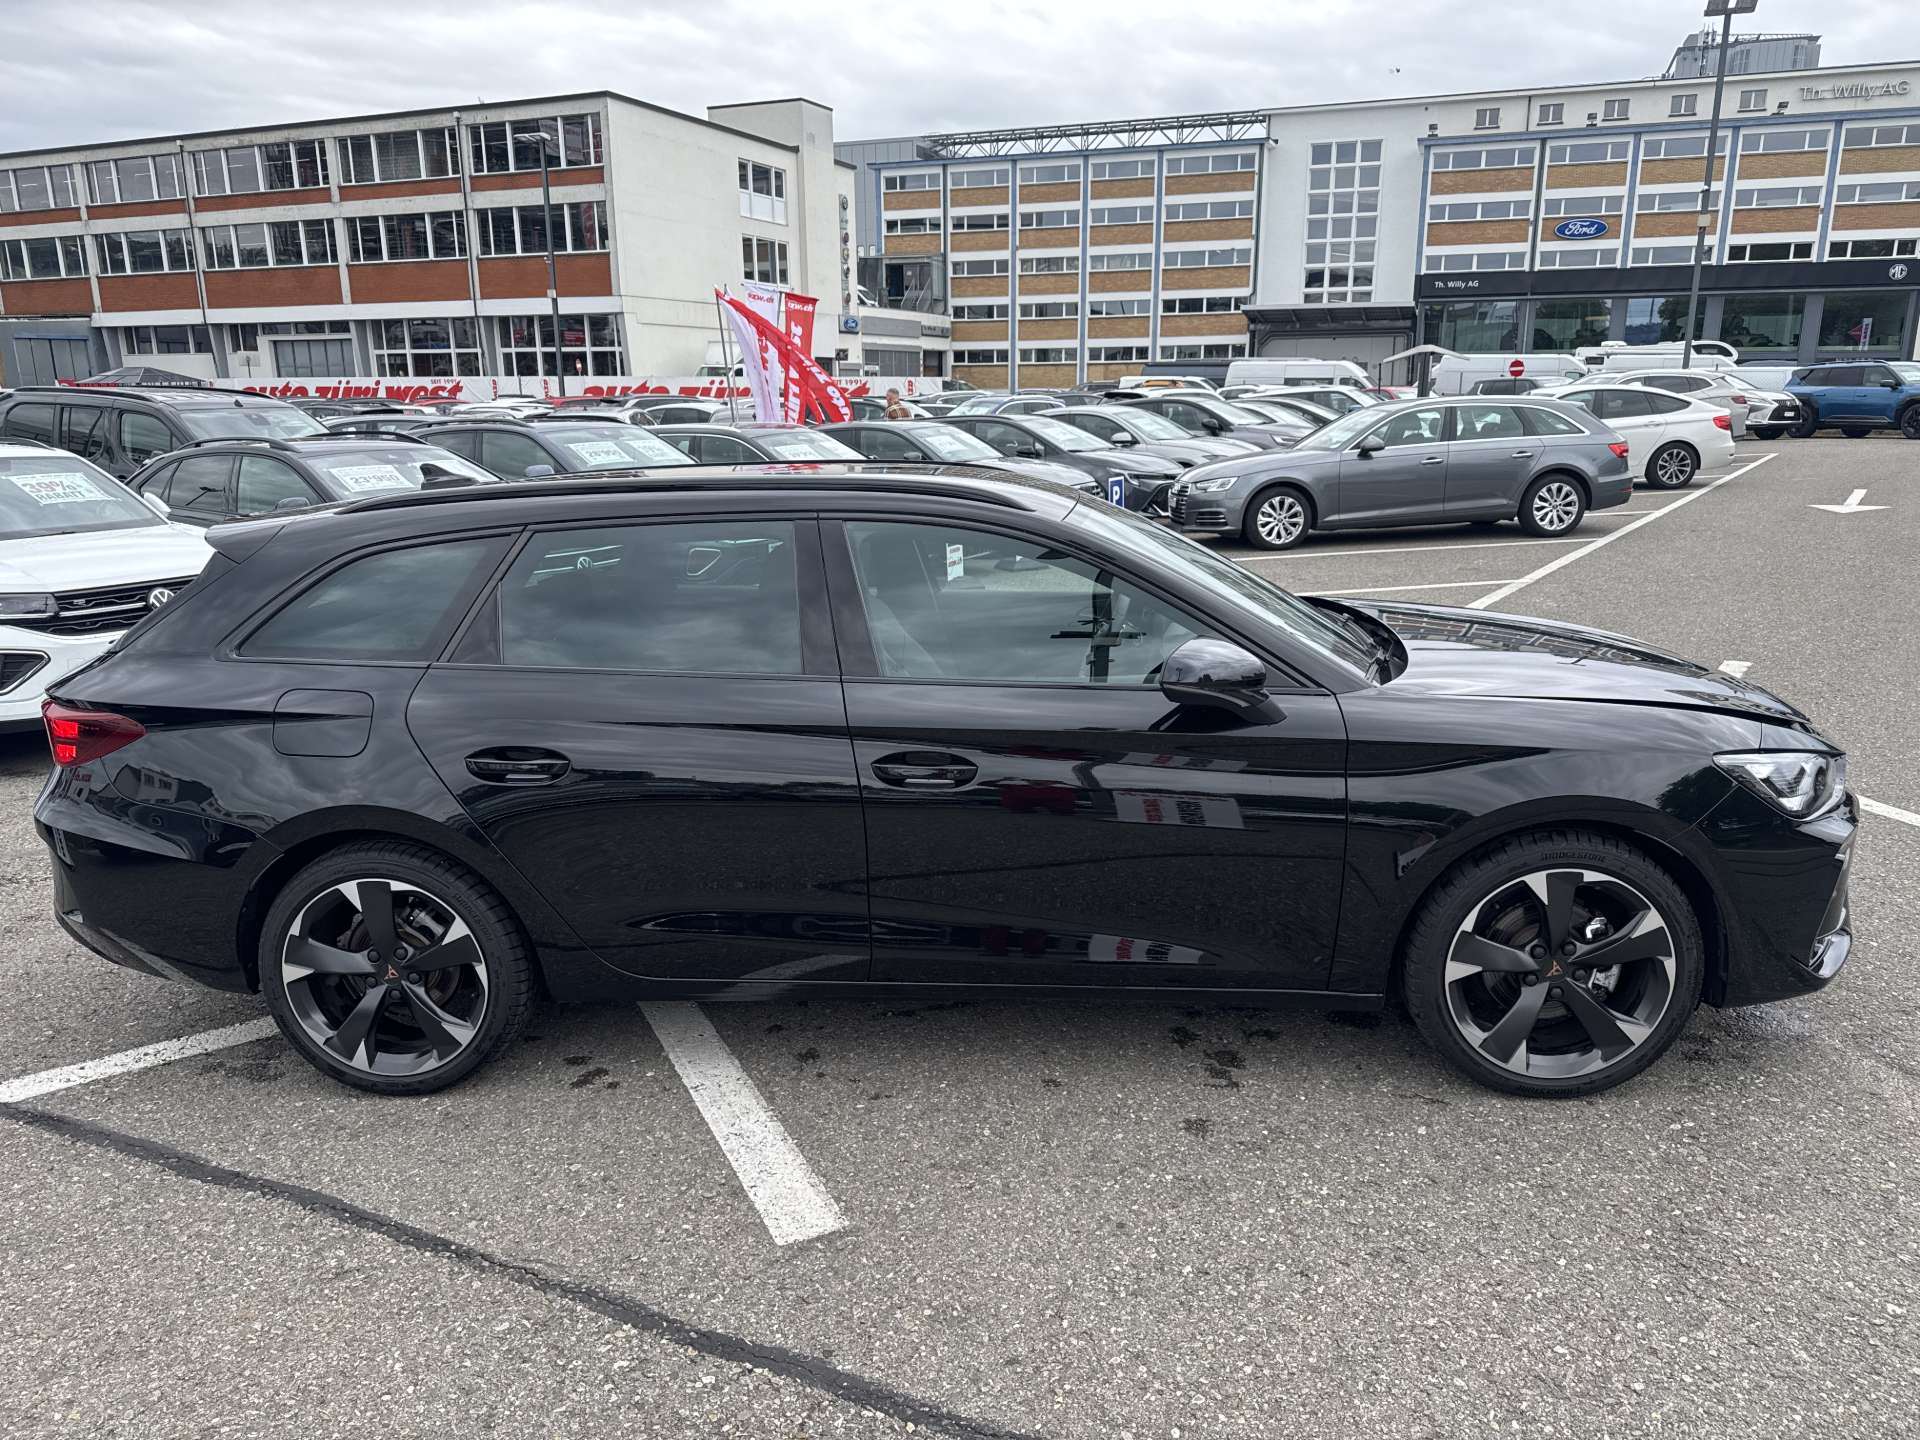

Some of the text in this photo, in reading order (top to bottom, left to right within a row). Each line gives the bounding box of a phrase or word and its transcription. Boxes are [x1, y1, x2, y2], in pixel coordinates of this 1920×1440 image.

[1833, 80, 1875, 101] Willy
[1881, 80, 1911, 96] AG
[1565, 220, 1598, 235] Ford
[1889, 264, 1908, 280] MG
[1447, 280, 1466, 290] Willy
[386, 379, 464, 402] west
[35, 492, 87, 502] RABATT
[1112, 485, 1121, 505] P
